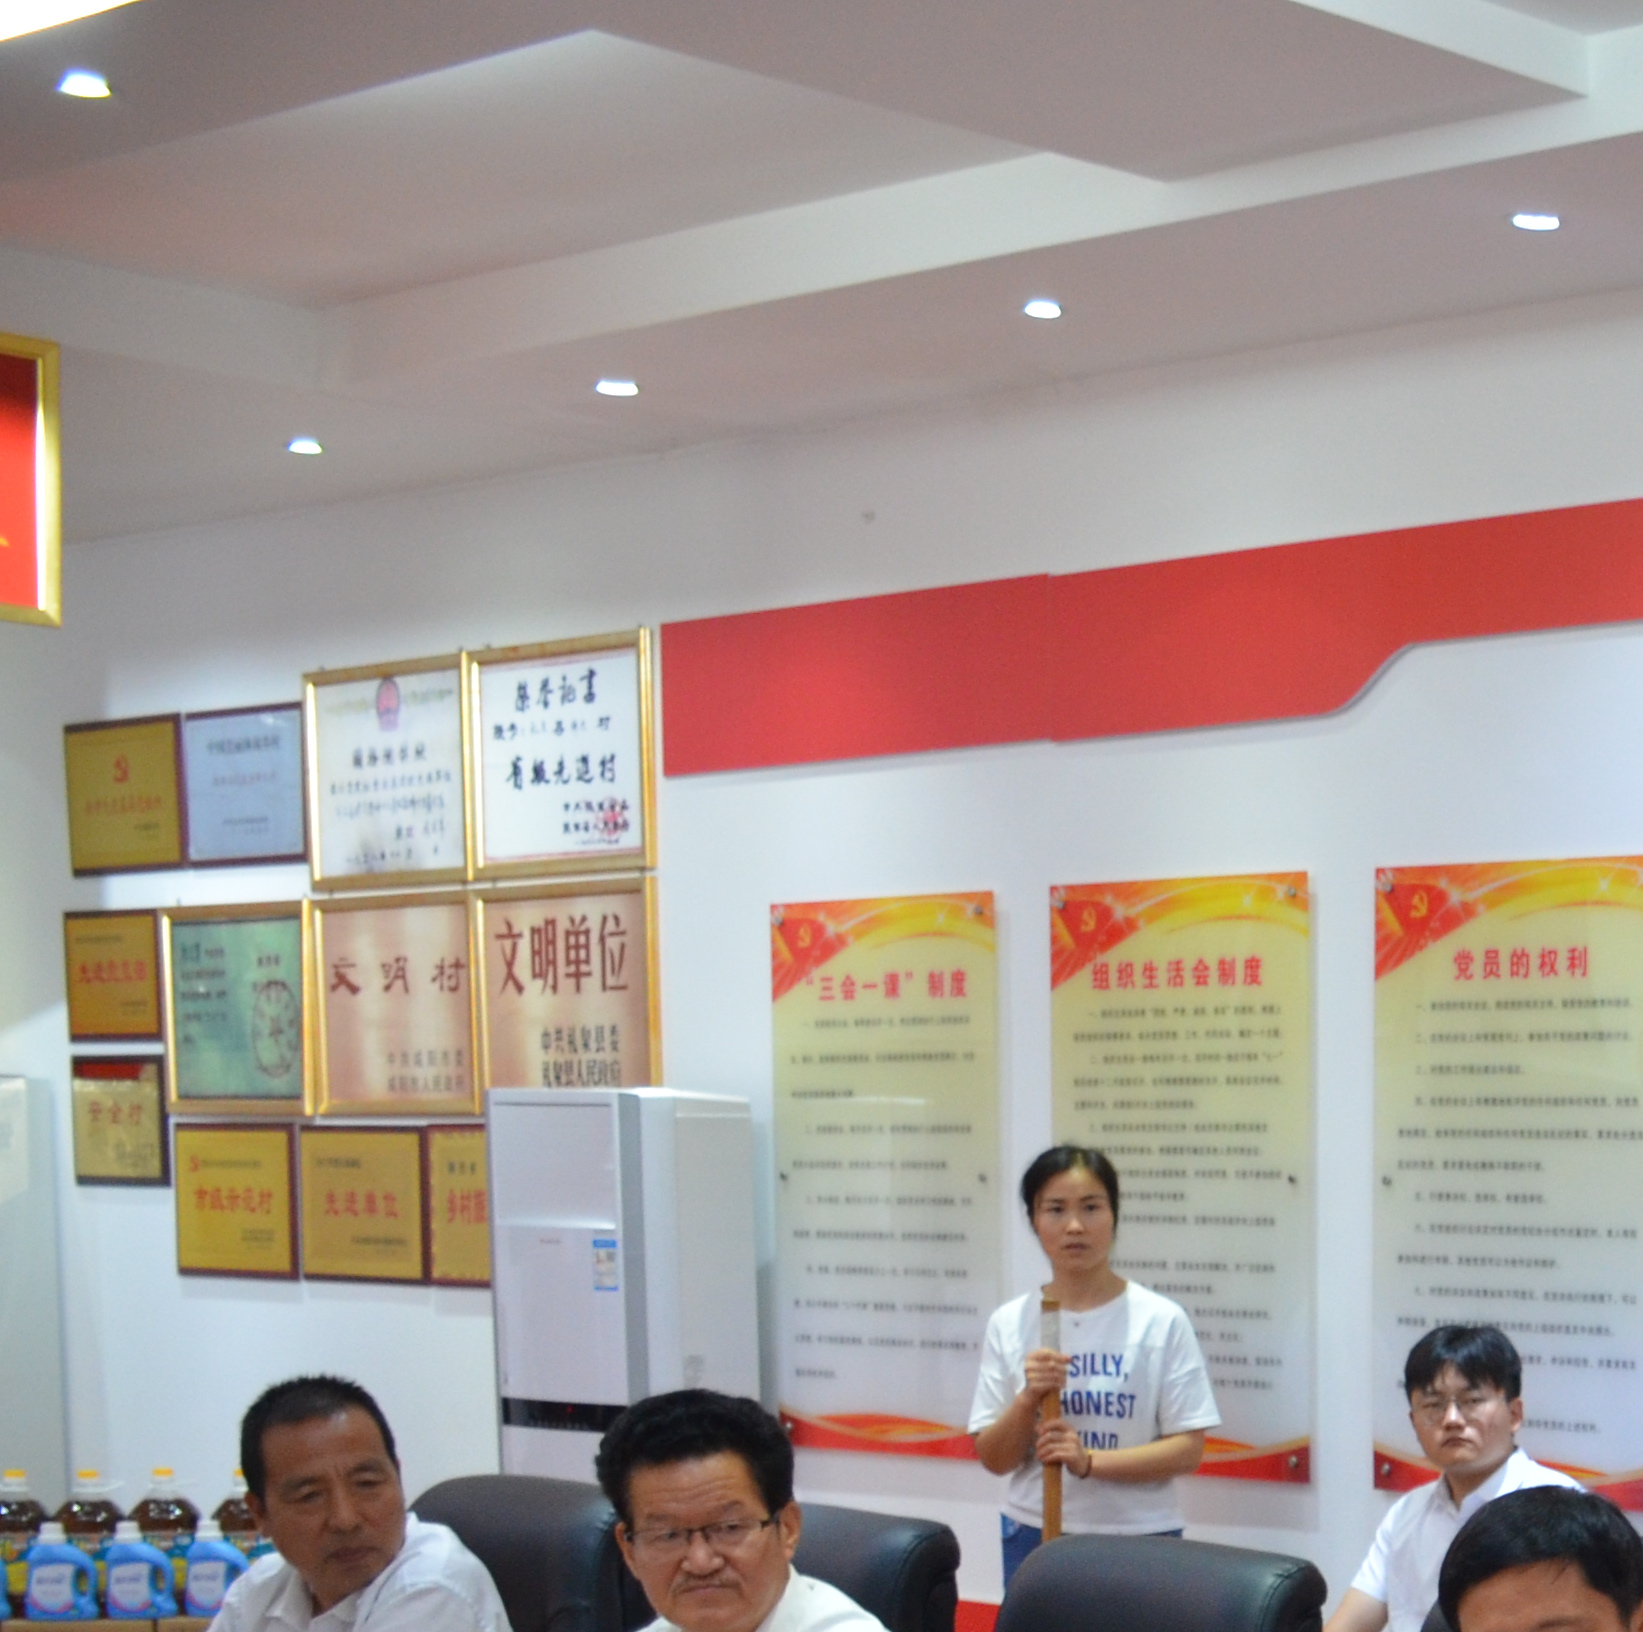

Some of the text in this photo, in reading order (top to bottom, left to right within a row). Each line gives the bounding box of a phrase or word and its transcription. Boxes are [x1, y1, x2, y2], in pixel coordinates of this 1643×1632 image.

[495, 912, 629, 996] 文明单位
[1452, 945, 1589, 982] 党员的权利
[330, 956, 466, 996] 文明村
[1090, 955, 1264, 991] 组织生活会制度
[1069, 1352, 1129, 1382] SILLY,
[1077, 1431, 1119, 1450] IND
